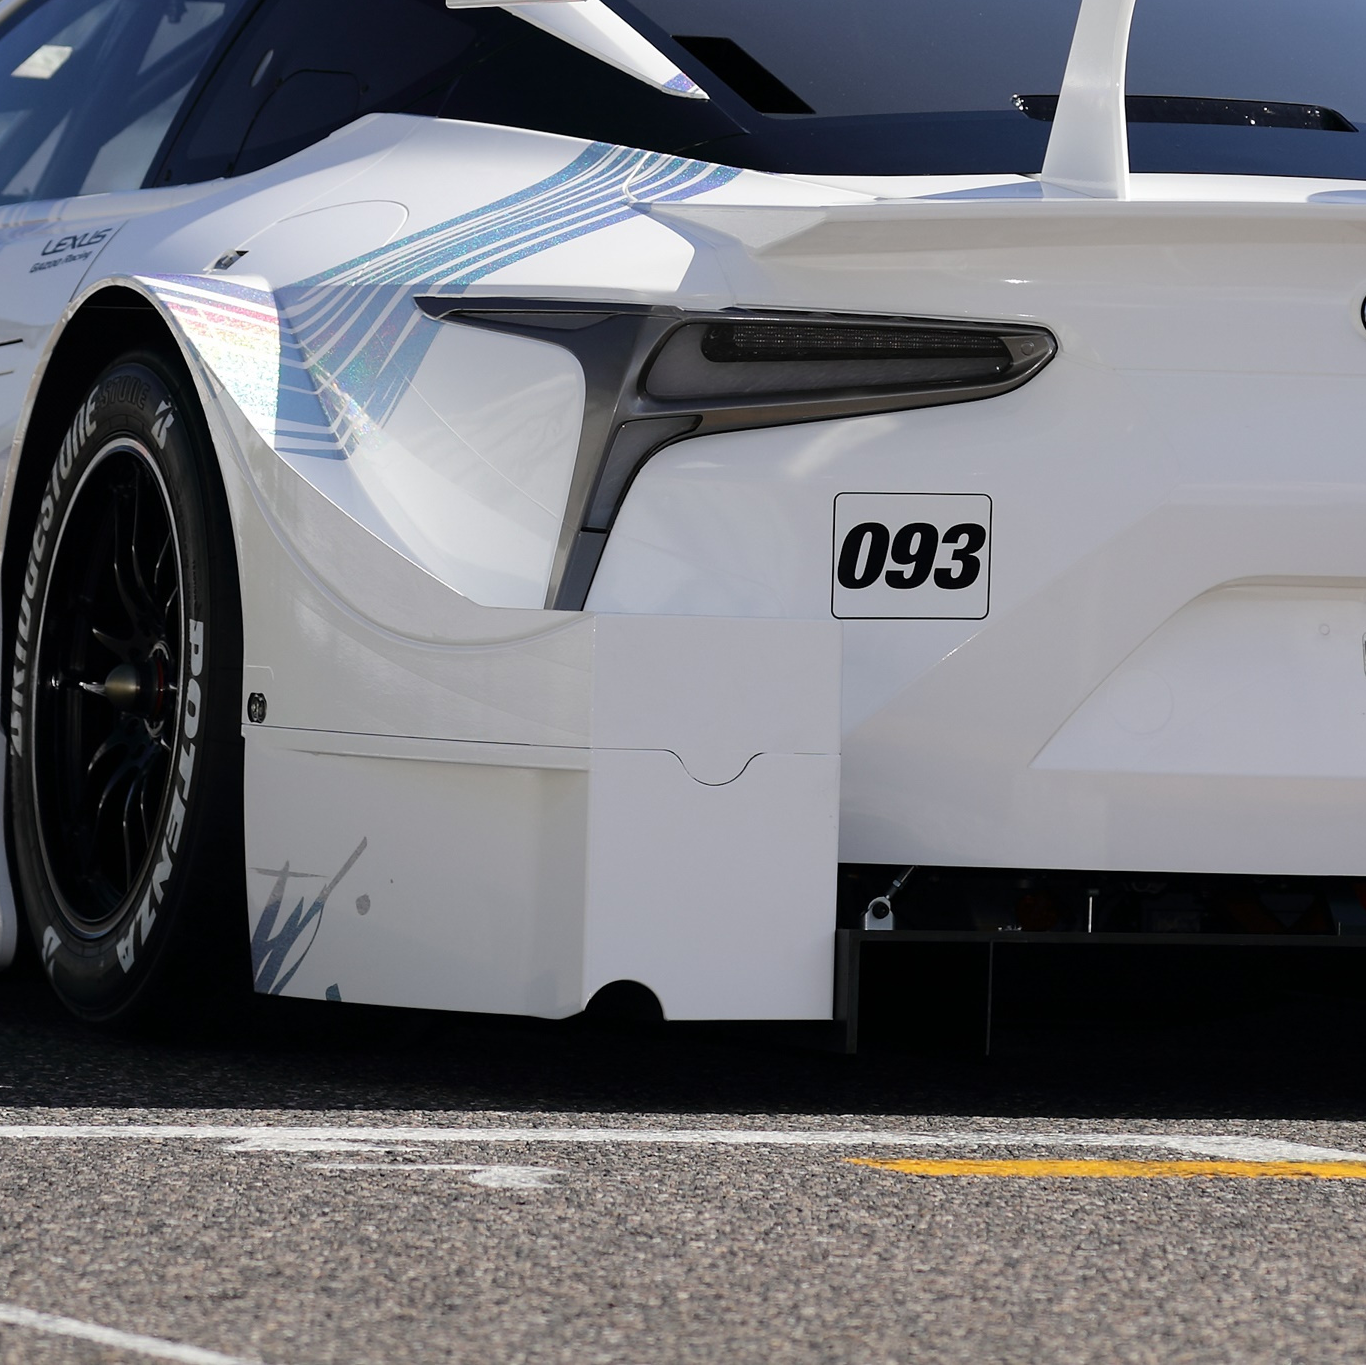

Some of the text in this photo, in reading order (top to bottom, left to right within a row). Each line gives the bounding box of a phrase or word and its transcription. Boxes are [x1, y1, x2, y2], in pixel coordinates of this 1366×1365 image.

[41, 228, 113, 256] LEXUS
[11, 384, 99, 757] BRIDGESTONE
[837, 521, 987, 590] 093
[115, 618, 204, 974] POTENZA
